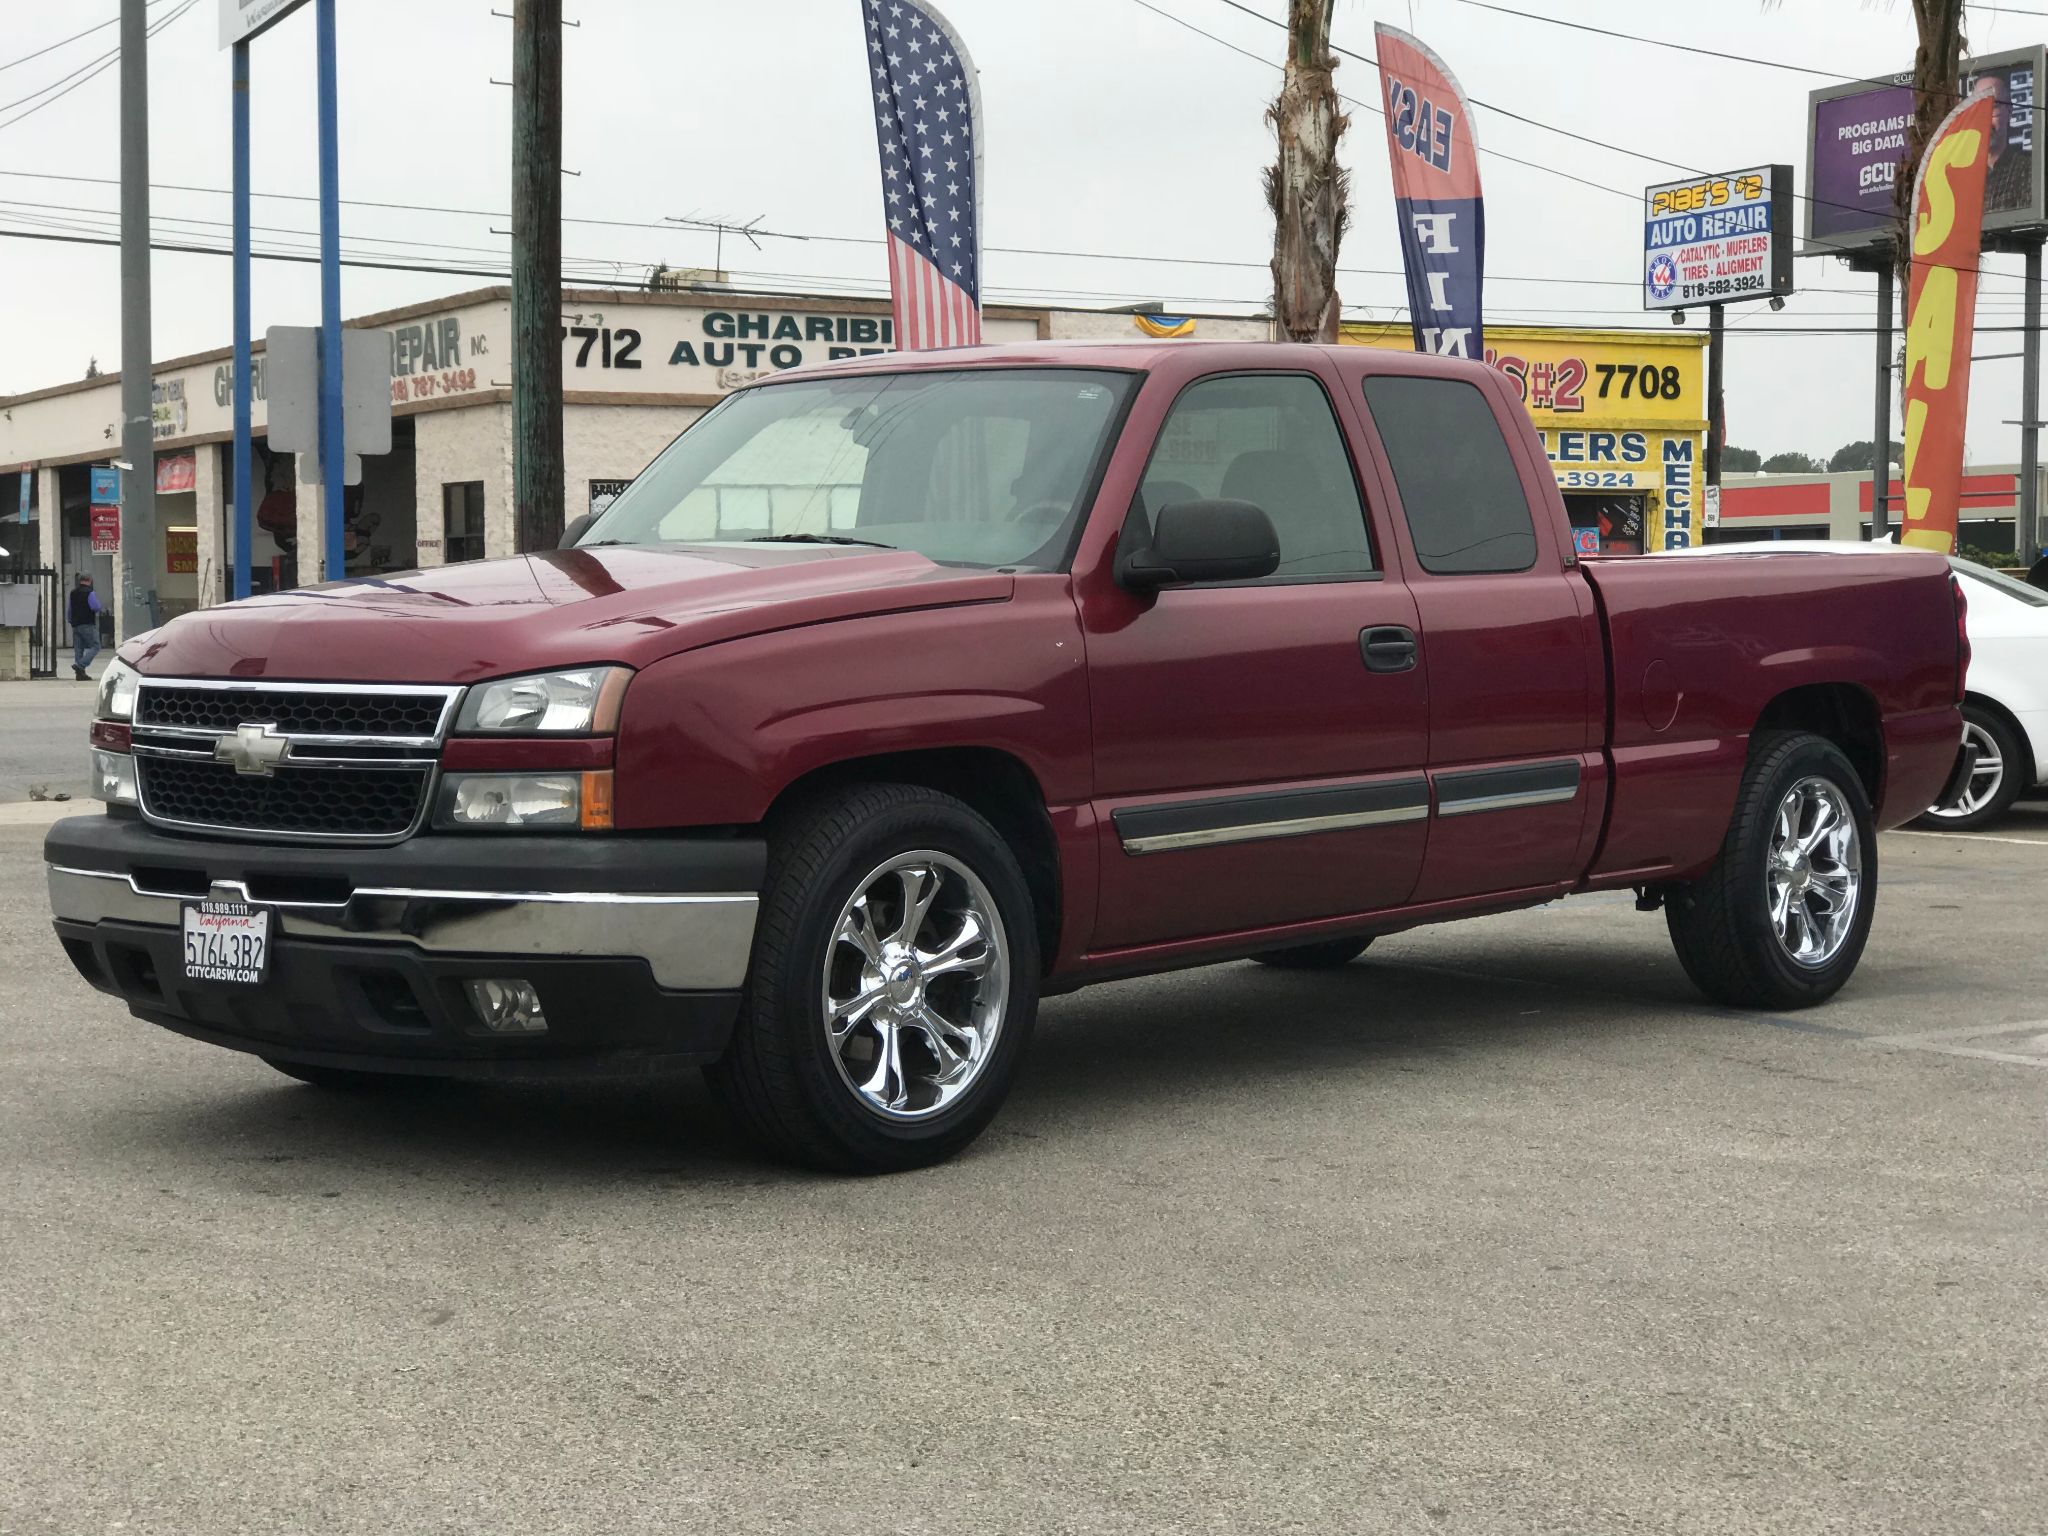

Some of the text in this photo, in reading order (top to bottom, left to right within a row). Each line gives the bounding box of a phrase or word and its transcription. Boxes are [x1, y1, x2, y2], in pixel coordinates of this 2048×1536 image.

[1838, 115, 1905, 141] PROGRAMS
[1851, 133, 1905, 155] BIG DATA
[1859, 162, 1896, 187] GCU
[1652, 174, 1763, 217] PIBE'S #2
[1650, 205, 1768, 247] AUTO REPAIR
[1680, 235, 1768, 264] CATALYTIC MUFFLERS
[1682, 255, 1764, 281] TIRES ALIGMENT
[1682, 274, 1766, 299] 818-582-3924
[701, 312, 893, 344] GHARIBI
[1902, 127, 1983, 554] SAL
[668, 341, 803, 369] AUTO
[1531, 357, 1588, 413] #2
[1595, 363, 1682, 400] 7708
[92, 540, 119, 551] OFFICE
[201, 902, 248, 914] 818.989.1111
[200, 913, 255, 932] California
[186, 931, 264, 969] 57643B2
[186, 965, 258, 982] CITYCARSW.COM
